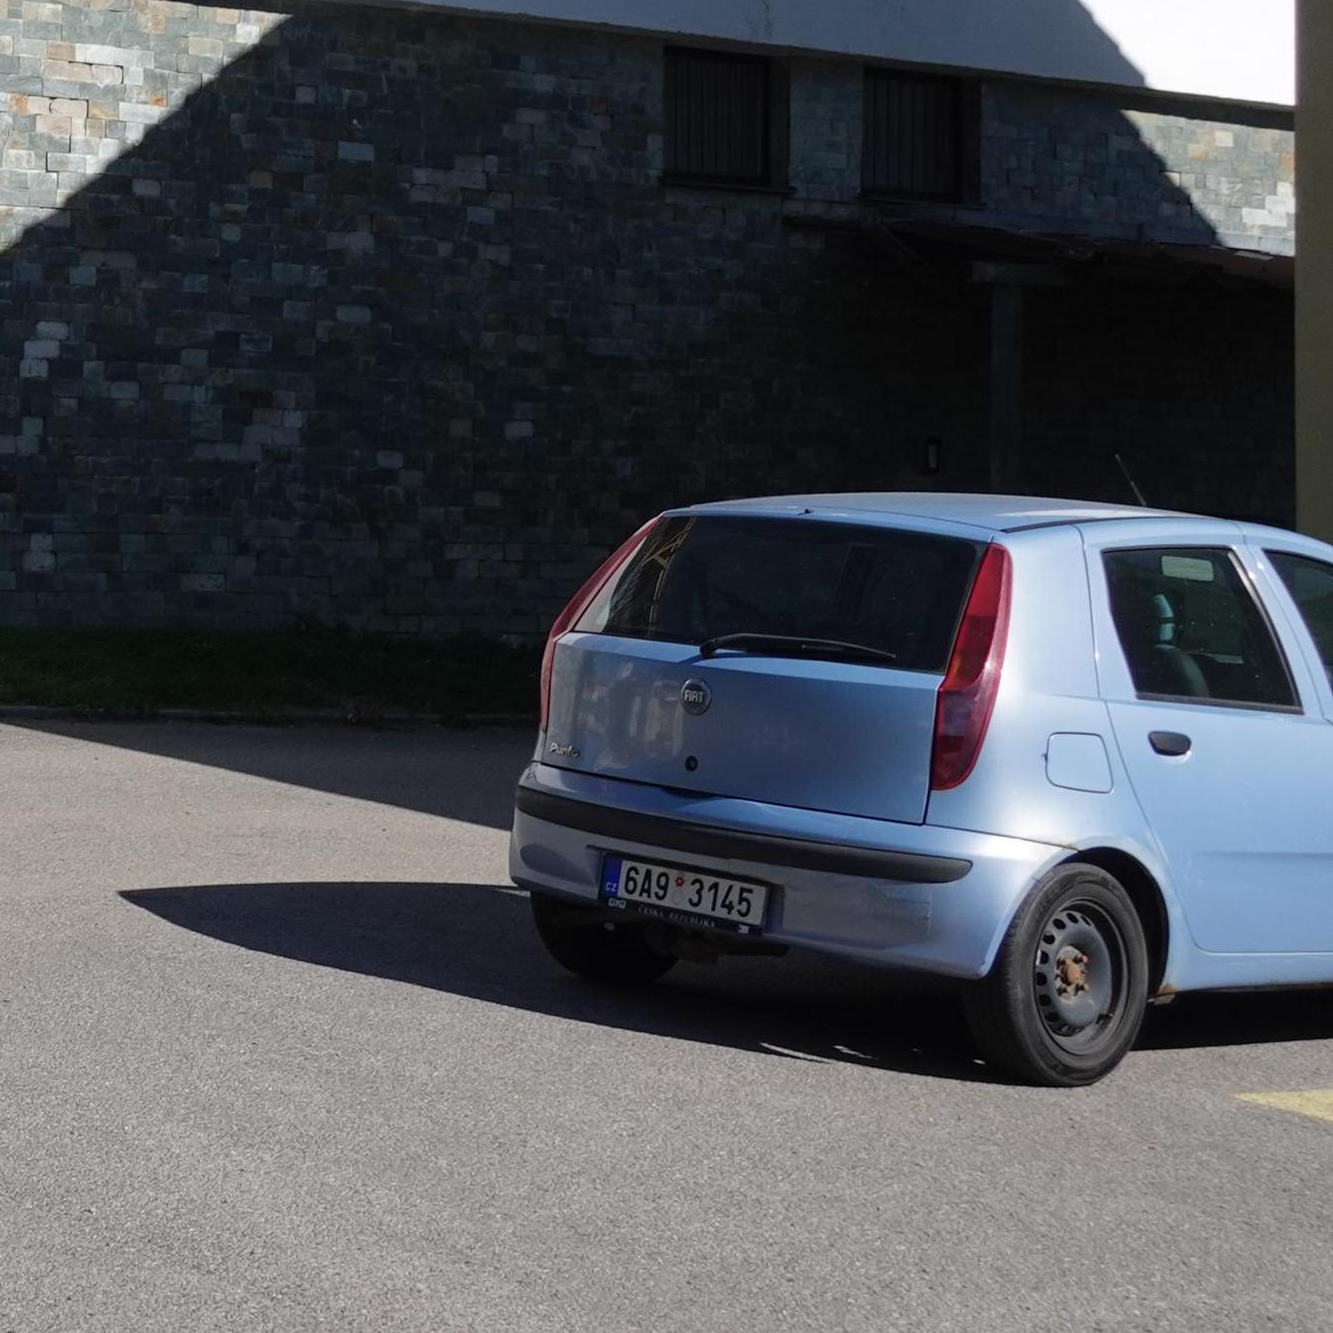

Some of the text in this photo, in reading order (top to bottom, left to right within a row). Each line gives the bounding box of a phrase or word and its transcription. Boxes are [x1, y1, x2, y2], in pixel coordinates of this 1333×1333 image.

[684, 689, 704, 703] FIAT
[605, 881, 618, 892] CZ
[624, 866, 754, 918] 6A9 3145
